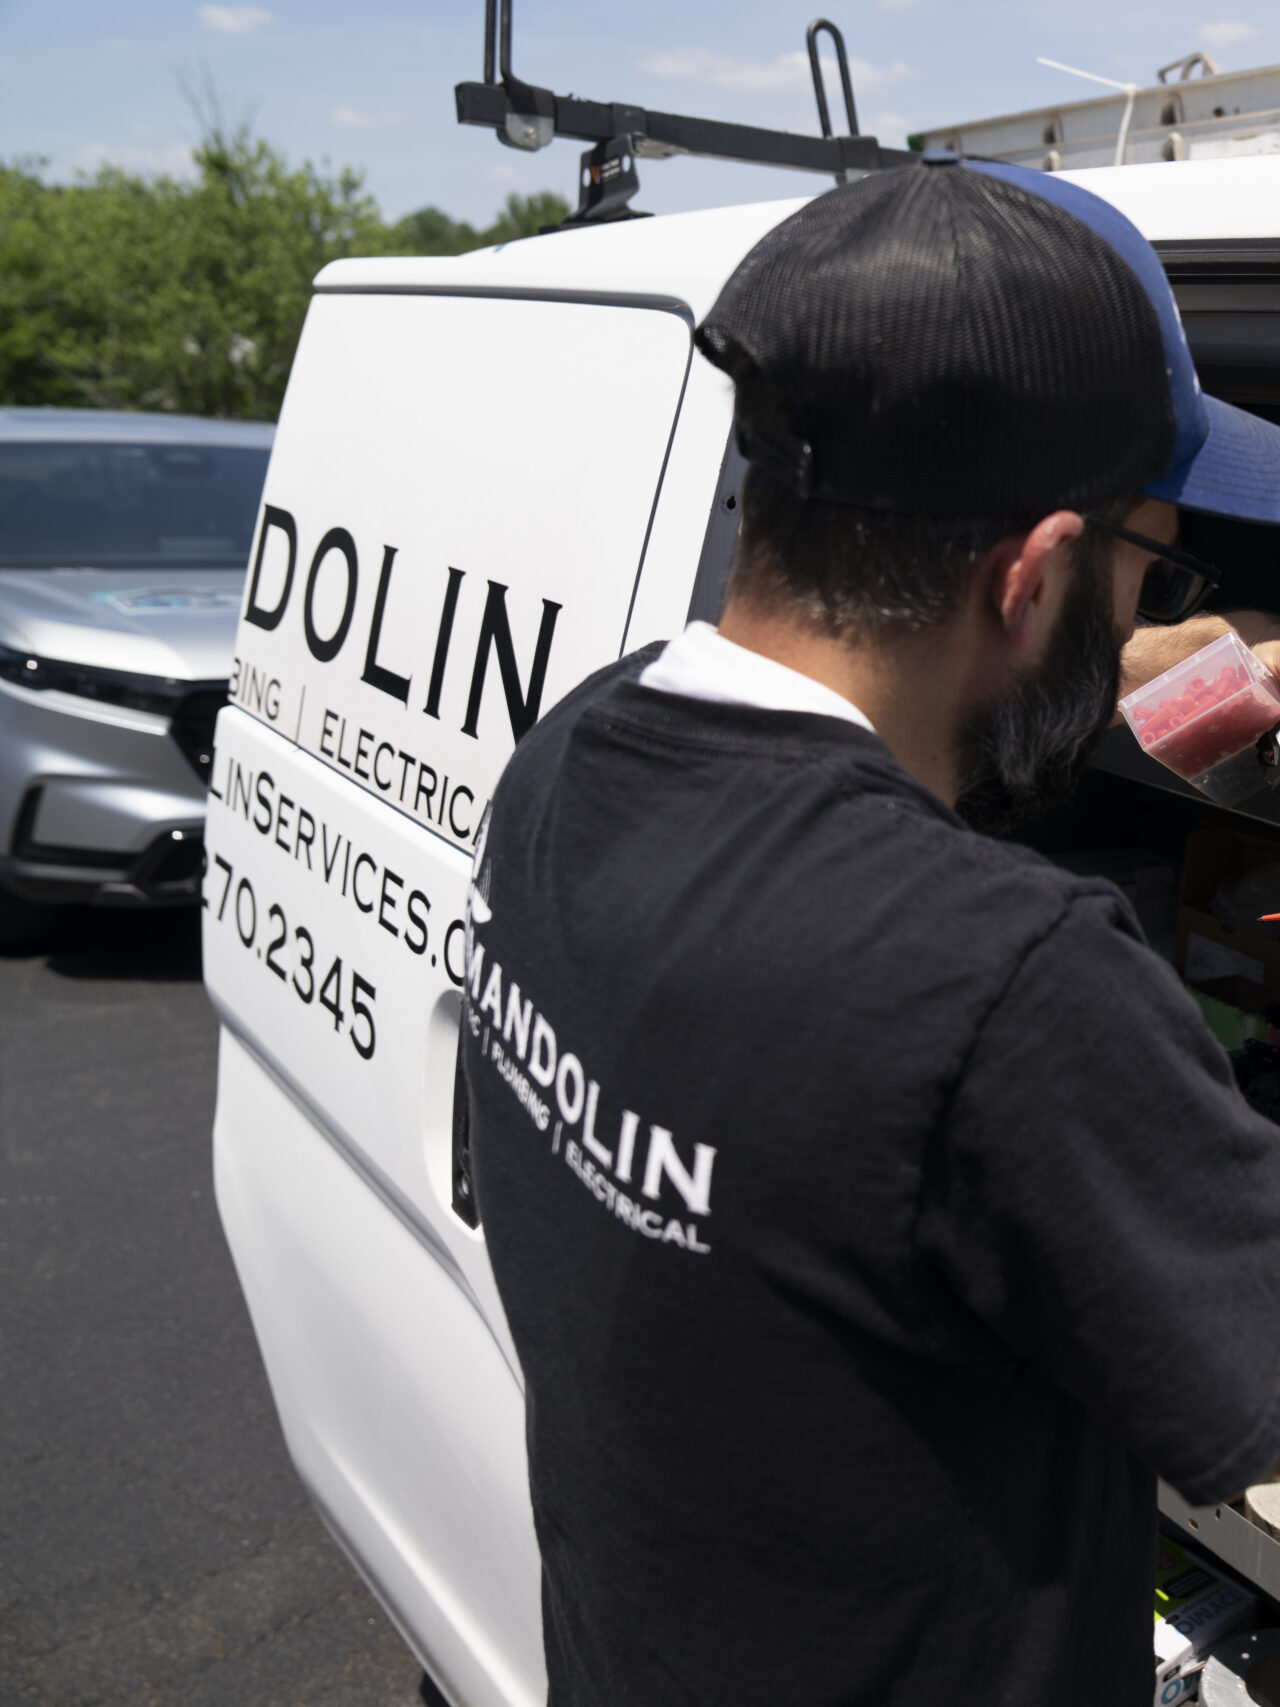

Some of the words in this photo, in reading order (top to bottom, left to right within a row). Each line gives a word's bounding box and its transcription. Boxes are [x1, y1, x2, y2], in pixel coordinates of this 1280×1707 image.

[243, 503, 563, 747] DOLIN
[491, 1040, 551, 1131] PLUMBING
[565, 1139, 711, 1254] ELECTRICAL
[1173, 1590, 1242, 1636] DYMO
